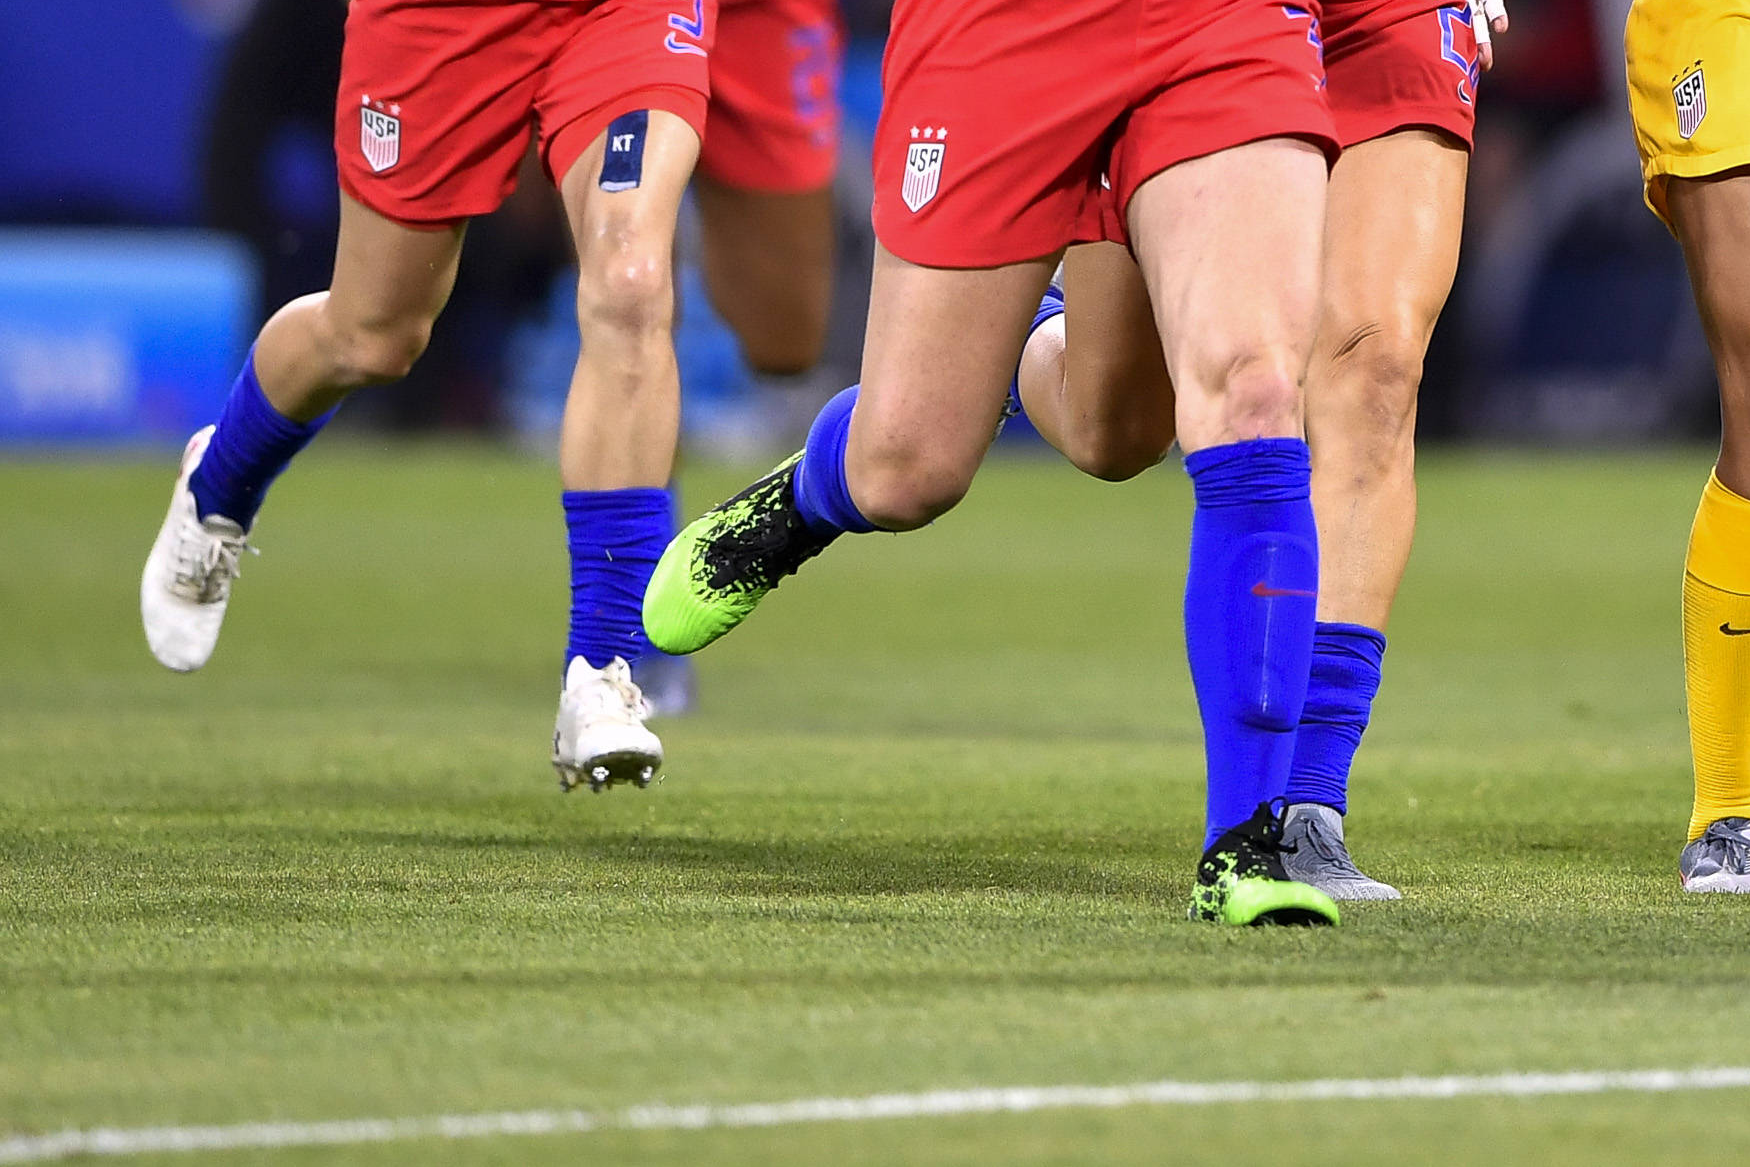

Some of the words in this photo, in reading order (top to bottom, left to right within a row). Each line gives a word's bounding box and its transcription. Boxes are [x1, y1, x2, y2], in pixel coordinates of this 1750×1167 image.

[1675, 74, 1701, 107] USA
[364, 110, 397, 138] USA
[612, 133, 635, 152] KT
[909, 148, 940, 173] USA
